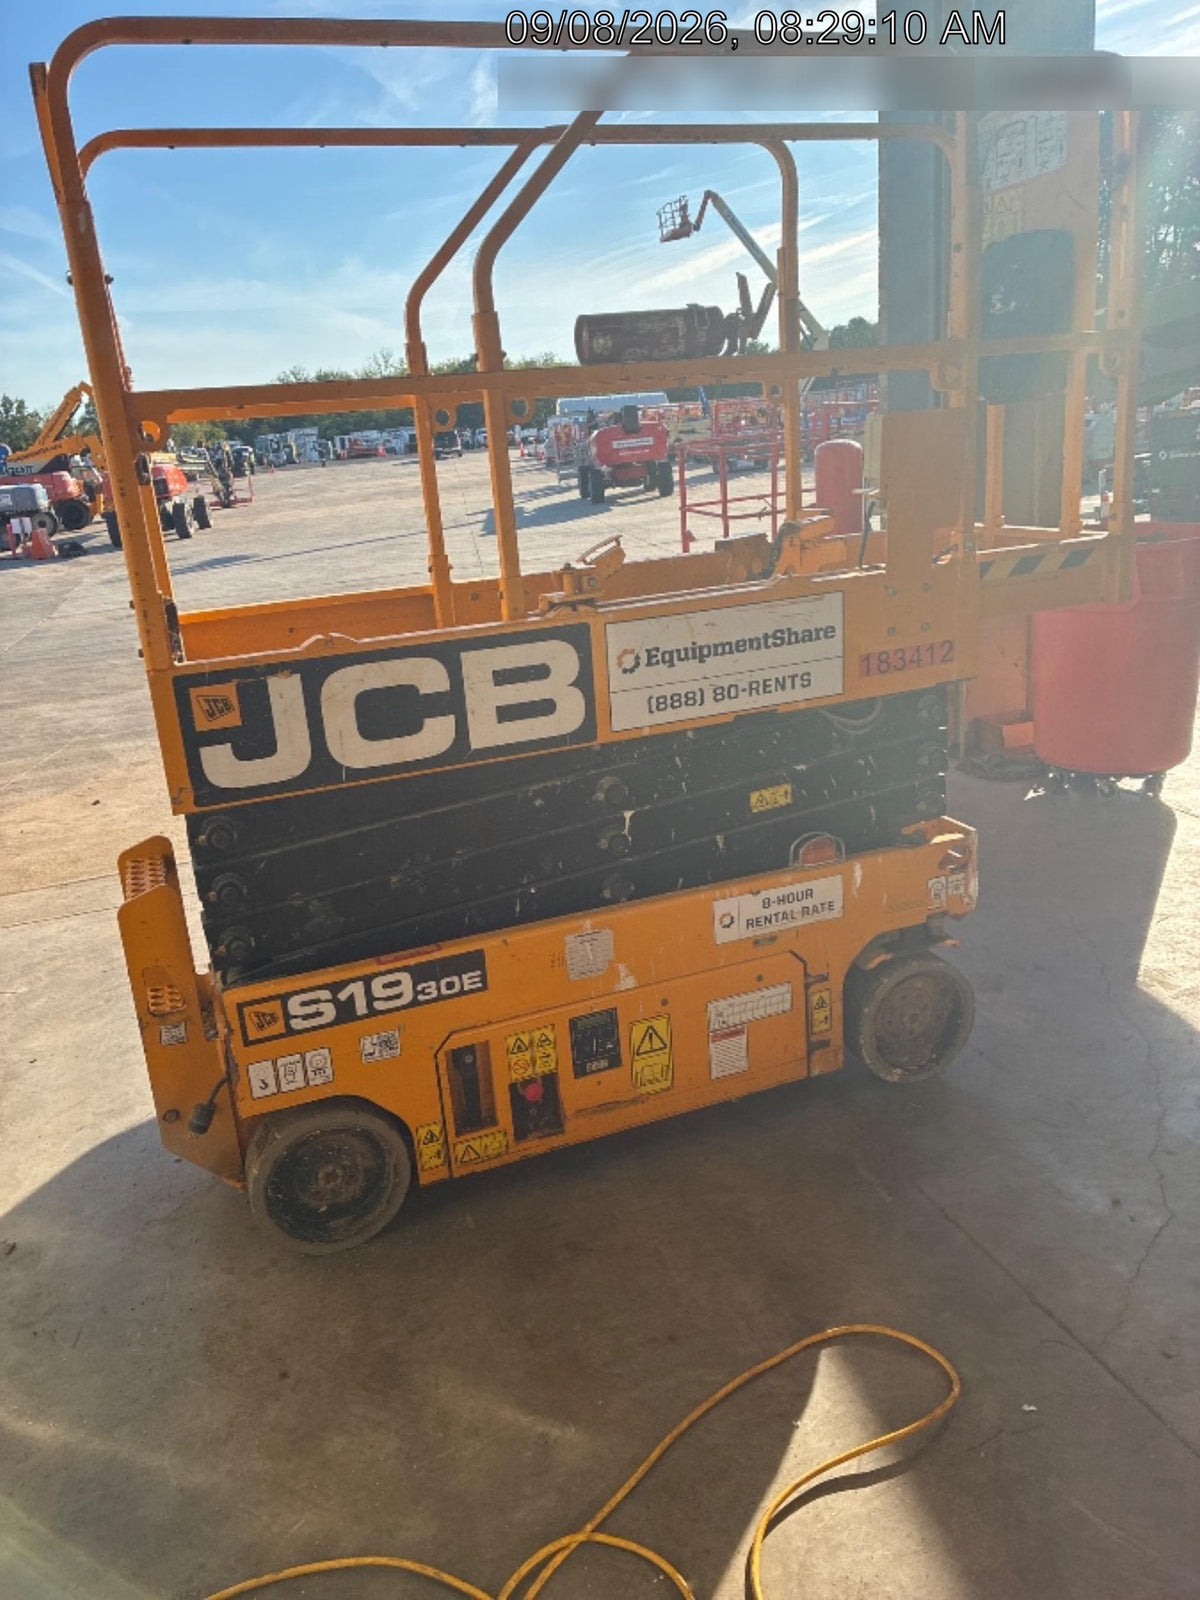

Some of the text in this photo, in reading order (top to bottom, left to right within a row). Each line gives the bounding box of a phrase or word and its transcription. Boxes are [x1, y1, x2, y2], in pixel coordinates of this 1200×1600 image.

[645, 623, 837, 669] EquipmentShare
[862, 639, 955, 677] 183412
[203, 698, 235, 718] JCB
[647, 671, 812, 713] (888) 80-RENTS
[199, 639, 586, 789] JCB
[746, 901, 835, 930] RENTAL RATE
[762, 888, 814, 909] 8-HOUR
